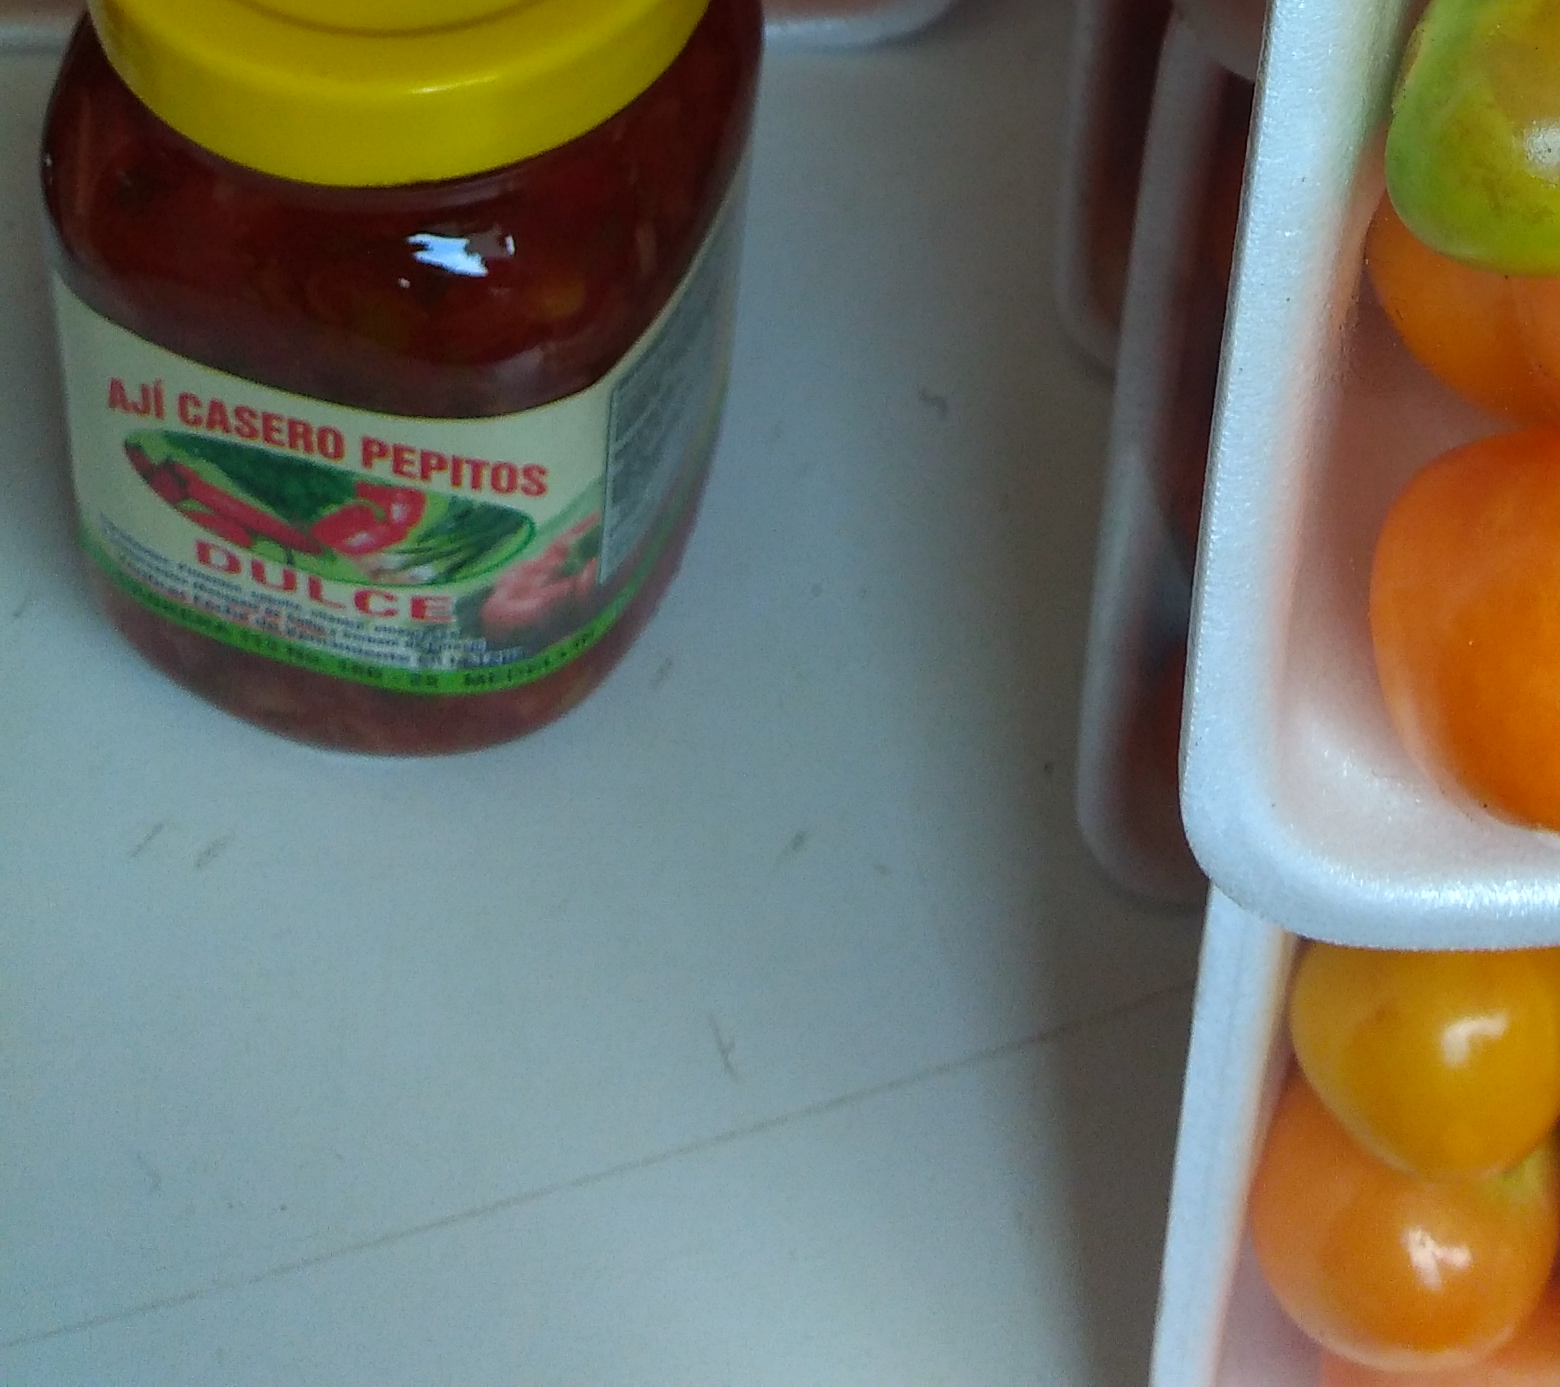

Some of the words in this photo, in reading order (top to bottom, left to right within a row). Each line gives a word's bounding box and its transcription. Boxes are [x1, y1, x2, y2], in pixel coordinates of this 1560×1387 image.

[108, 376, 165, 421] AJÍ
[176, 392, 346, 462] CASERO
[360, 436, 549, 498] PEPITOS
[195, 538, 456, 623] DULCE
